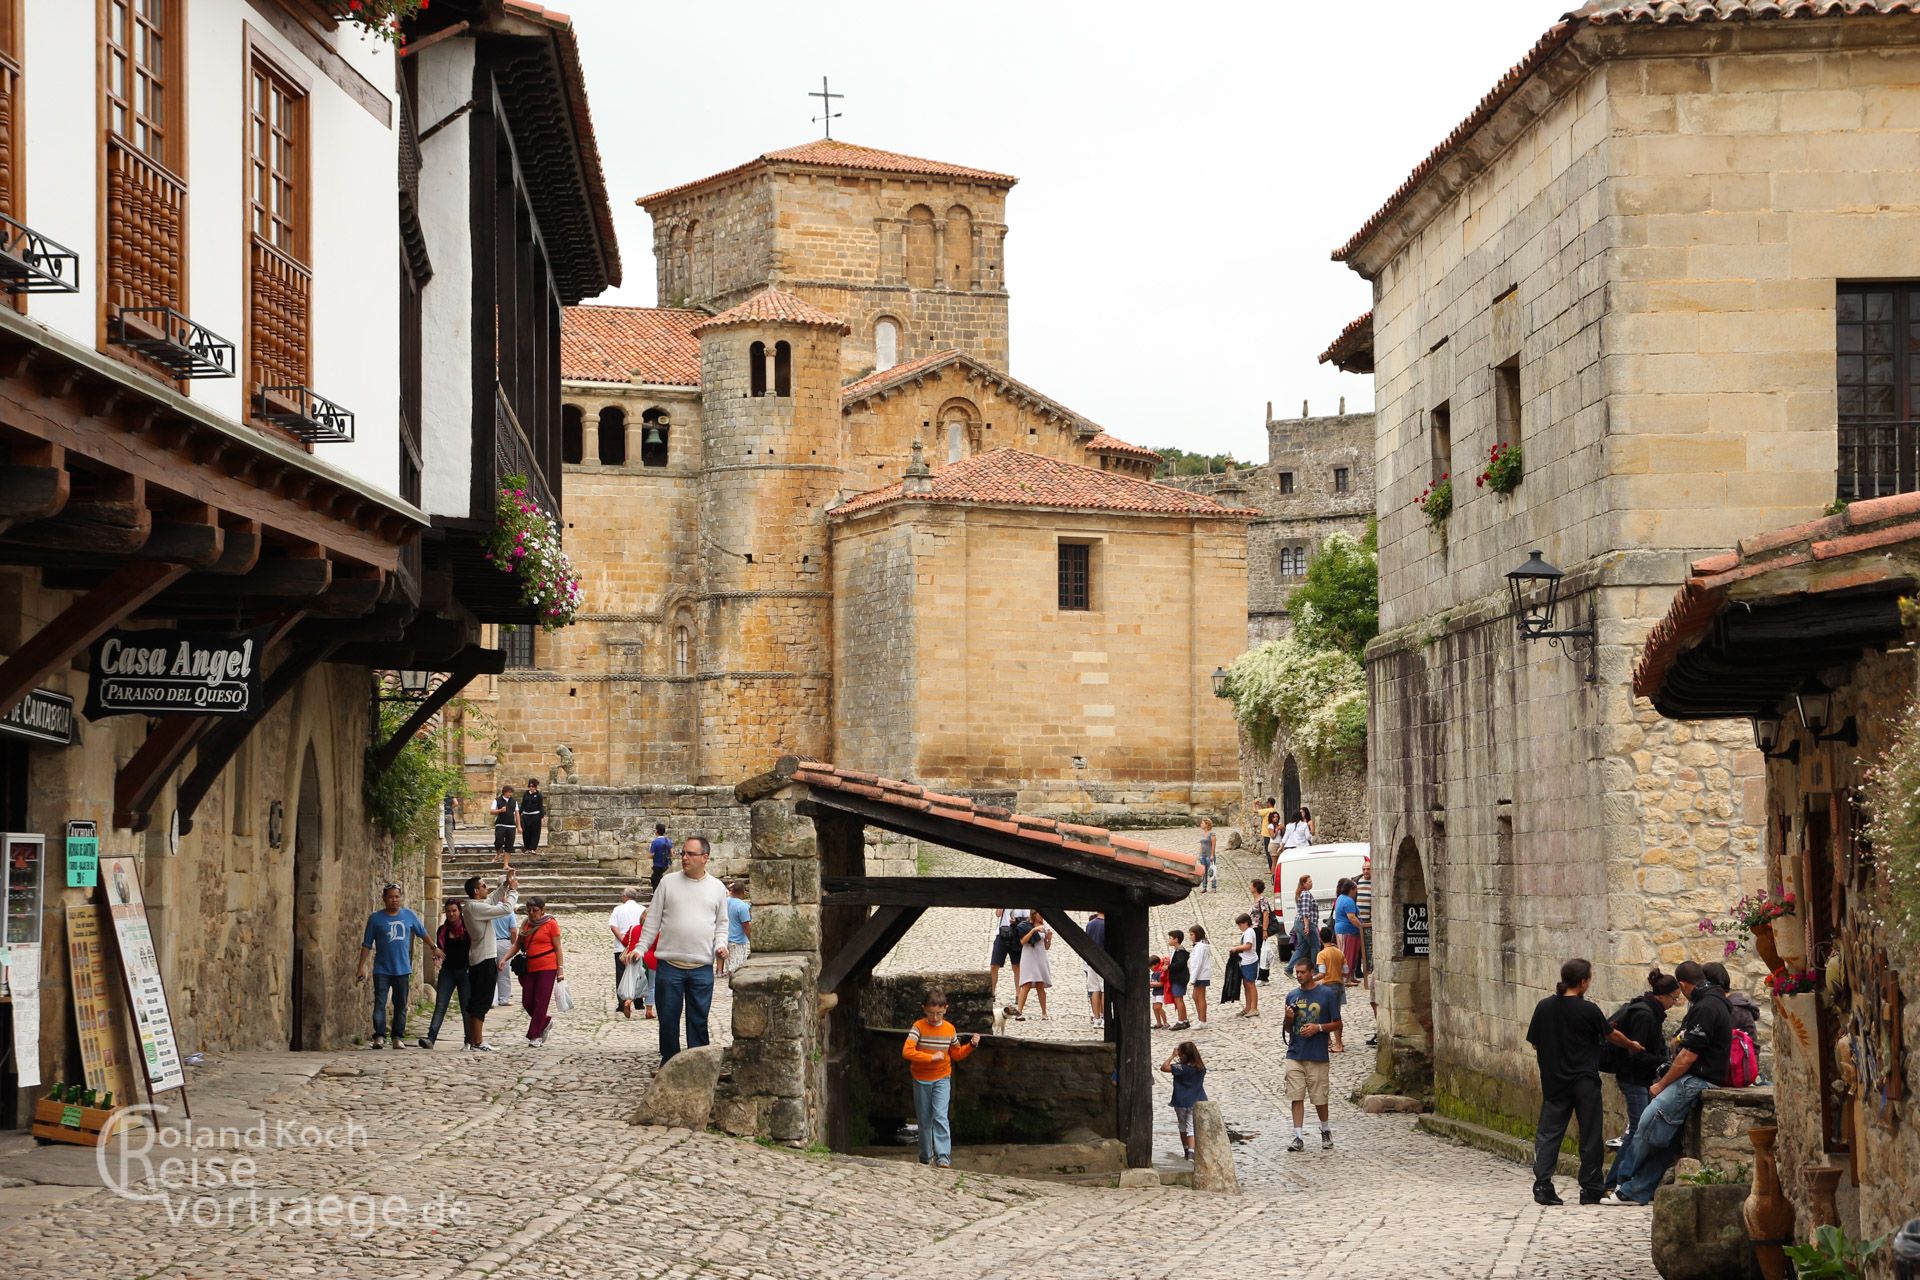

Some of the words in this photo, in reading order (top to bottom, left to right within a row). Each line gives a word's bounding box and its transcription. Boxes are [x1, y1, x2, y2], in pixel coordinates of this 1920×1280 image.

[101, 638, 167, 675] Casa
[170, 638, 253, 687] Angel
[23, 694, 70, 734] CANTABRIA
[106, 684, 165, 701] PARAISO
[166, 687, 192, 701] DEL
[194, 686, 243, 707] QUESO
